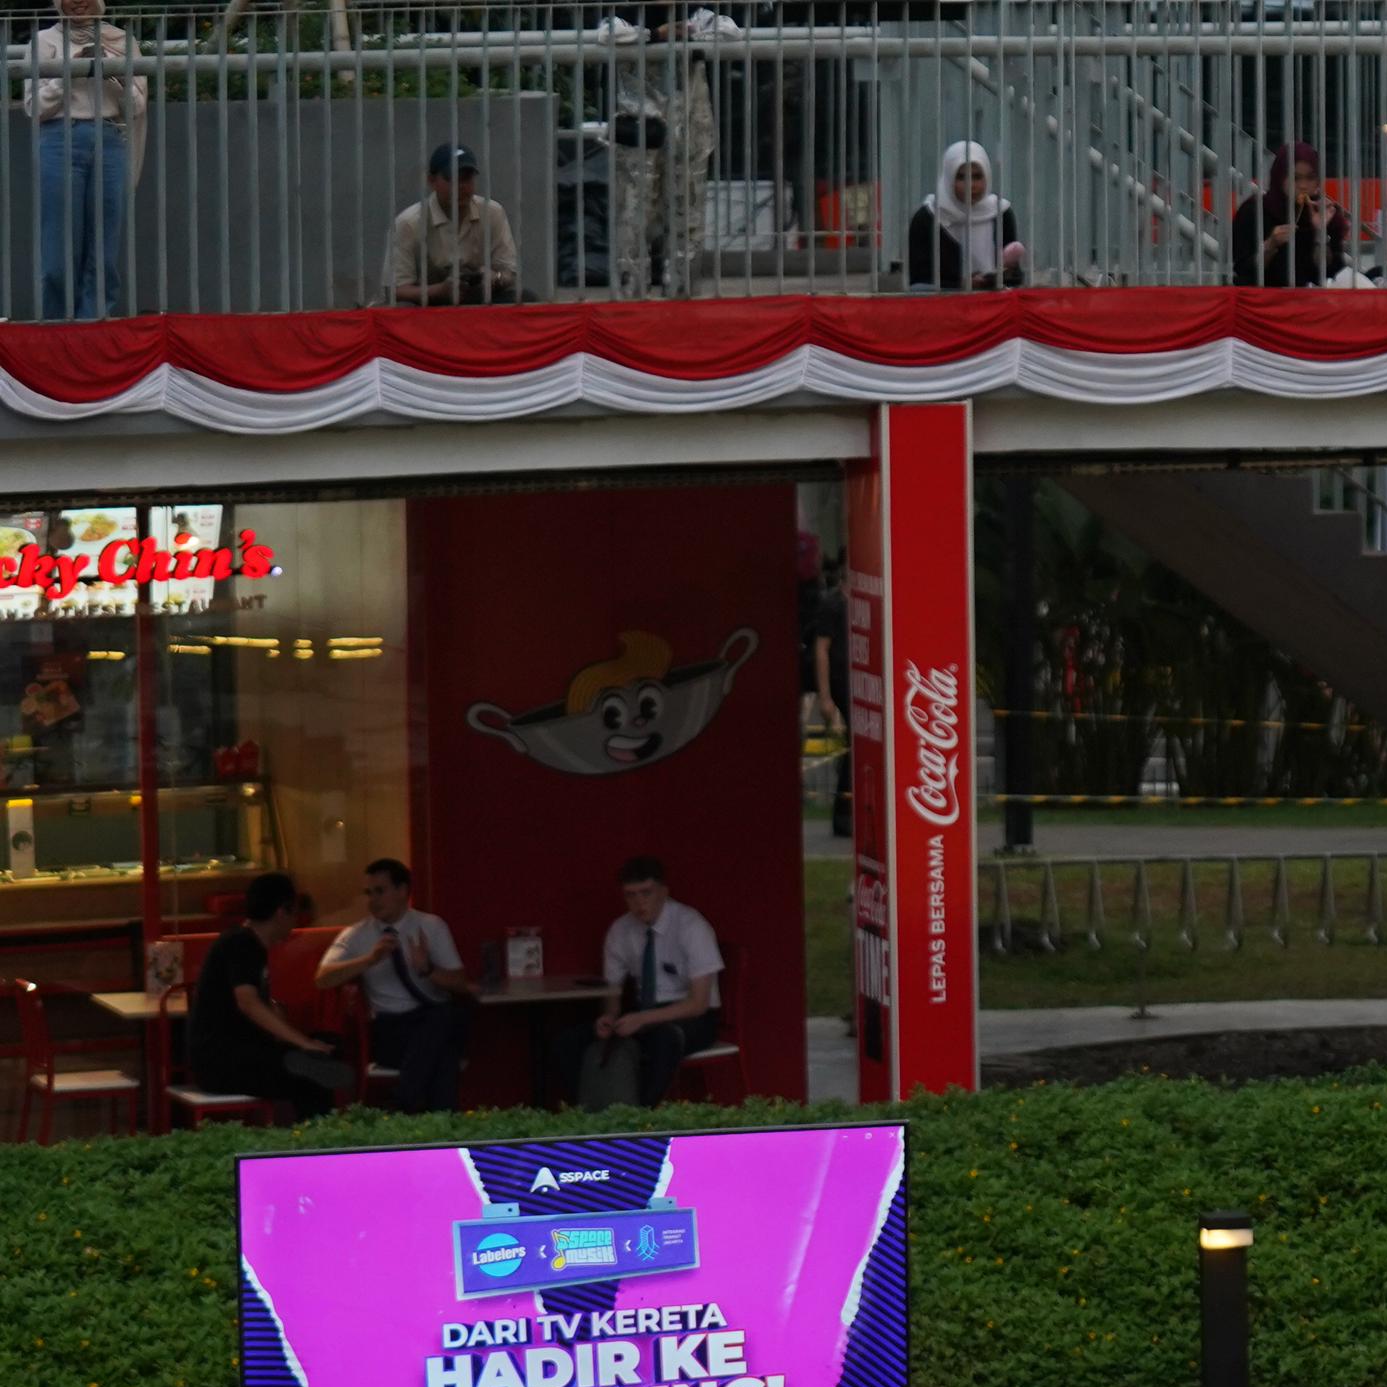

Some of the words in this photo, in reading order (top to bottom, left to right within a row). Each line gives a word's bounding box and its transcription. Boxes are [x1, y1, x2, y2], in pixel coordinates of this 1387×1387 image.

[99, 529, 275, 585] Chin's
[905, 658, 959, 826] Coca-Cola
[929, 835, 946, 935] BERSAMA
[931, 939, 948, 1004] LEPAS
[560, 1170, 610, 1183] SSPACE
[473, 1246, 526, 1265] Labelers
[443, 1318, 527, 1349] DARI
[537, 1313, 583, 1342] TV
[591, 1304, 727, 1336] KERETA
[660, 1331, 747, 1380] KE
